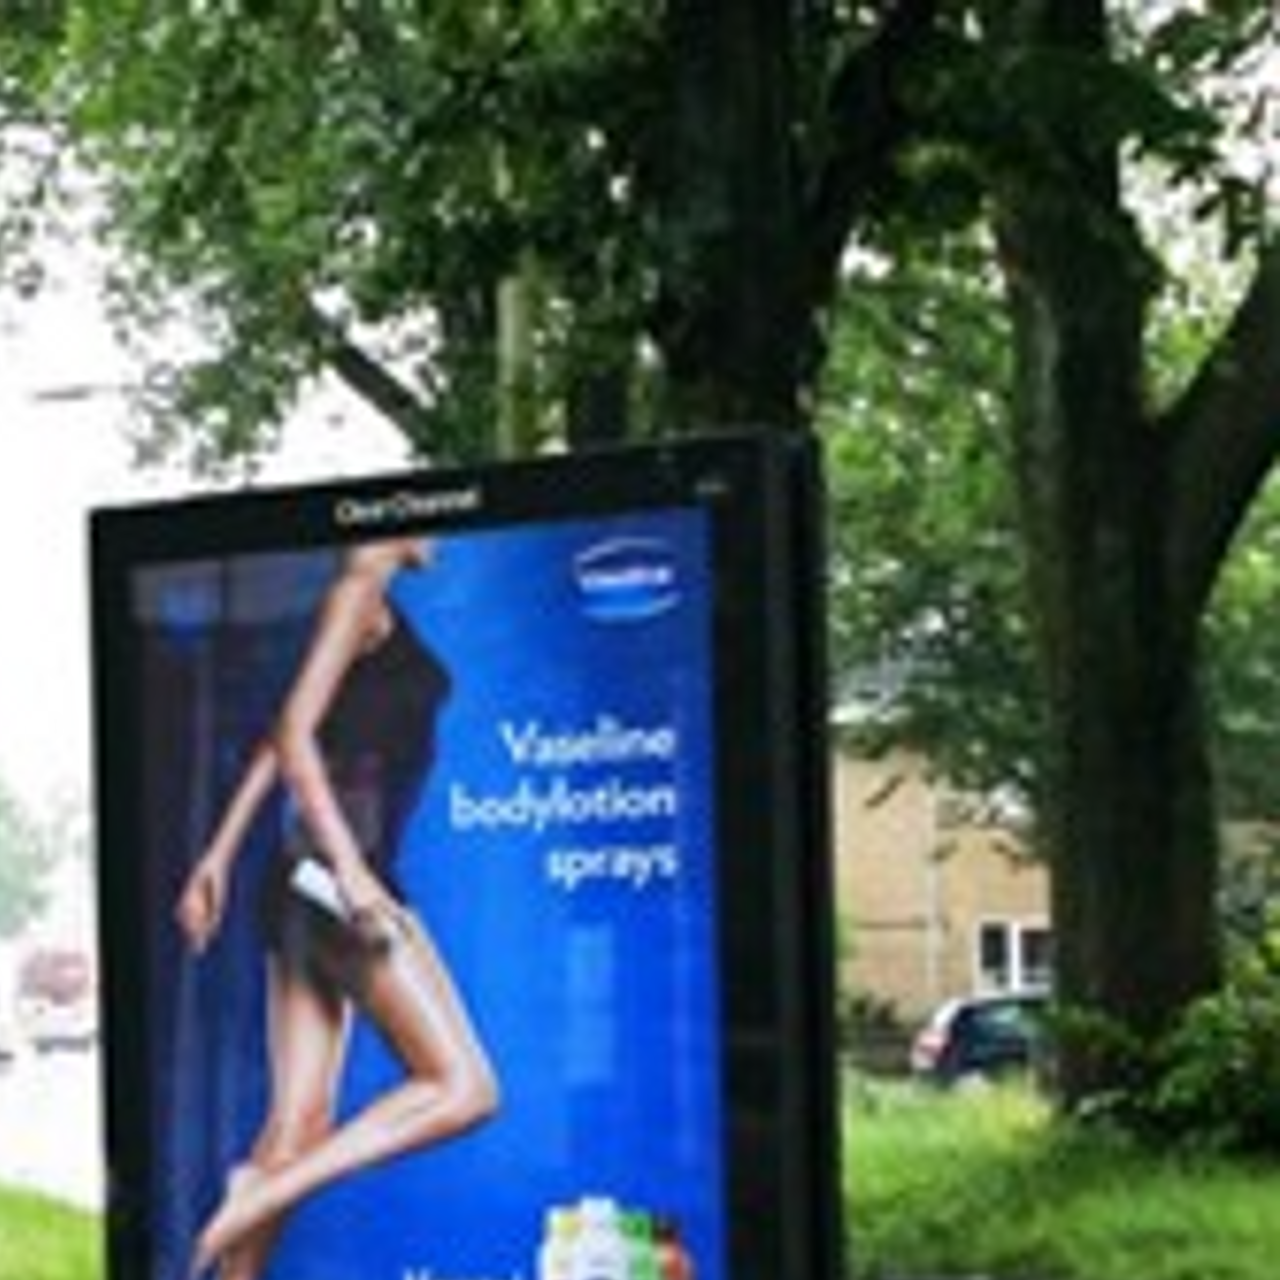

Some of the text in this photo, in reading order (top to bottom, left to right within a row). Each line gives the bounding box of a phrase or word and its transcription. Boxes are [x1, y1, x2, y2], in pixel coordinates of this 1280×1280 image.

[500, 715, 677, 766] Vaseline
[450, 776, 677, 834] bodylotion
[548, 846, 678, 892] sprays
